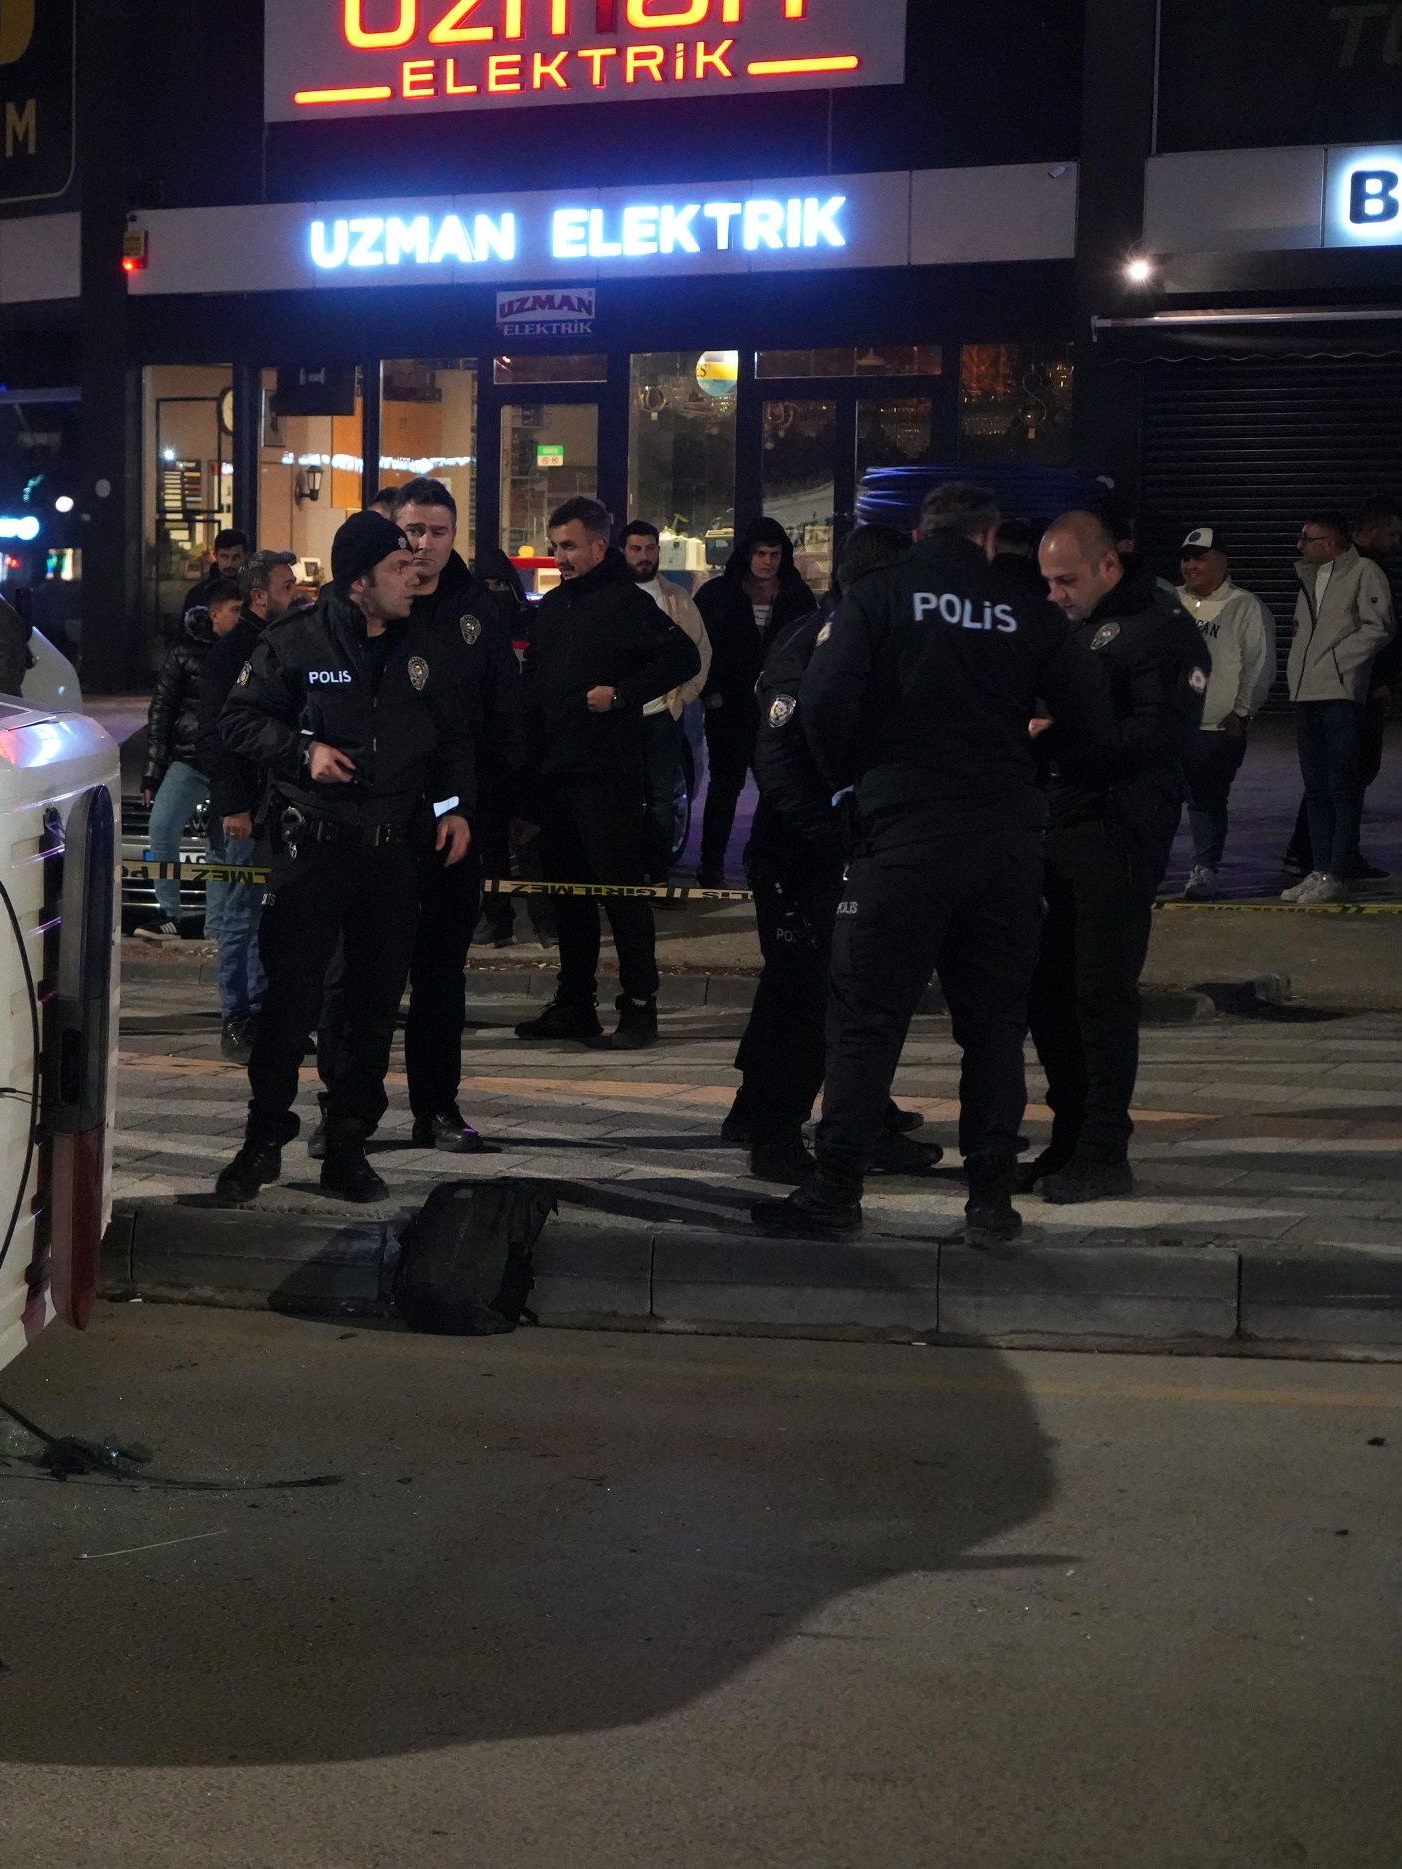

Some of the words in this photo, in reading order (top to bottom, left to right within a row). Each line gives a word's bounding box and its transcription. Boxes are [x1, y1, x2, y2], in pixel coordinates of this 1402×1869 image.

[401, 39, 734, 98] ELEKTRİK
[309, 211, 517, 268] UZMAN
[499, 294, 593, 319] UZMAN
[503, 320, 593, 336] ELEKTRİK
[913, 591, 1018, 634] POLİS
[308, 670, 352, 684] POLİS
